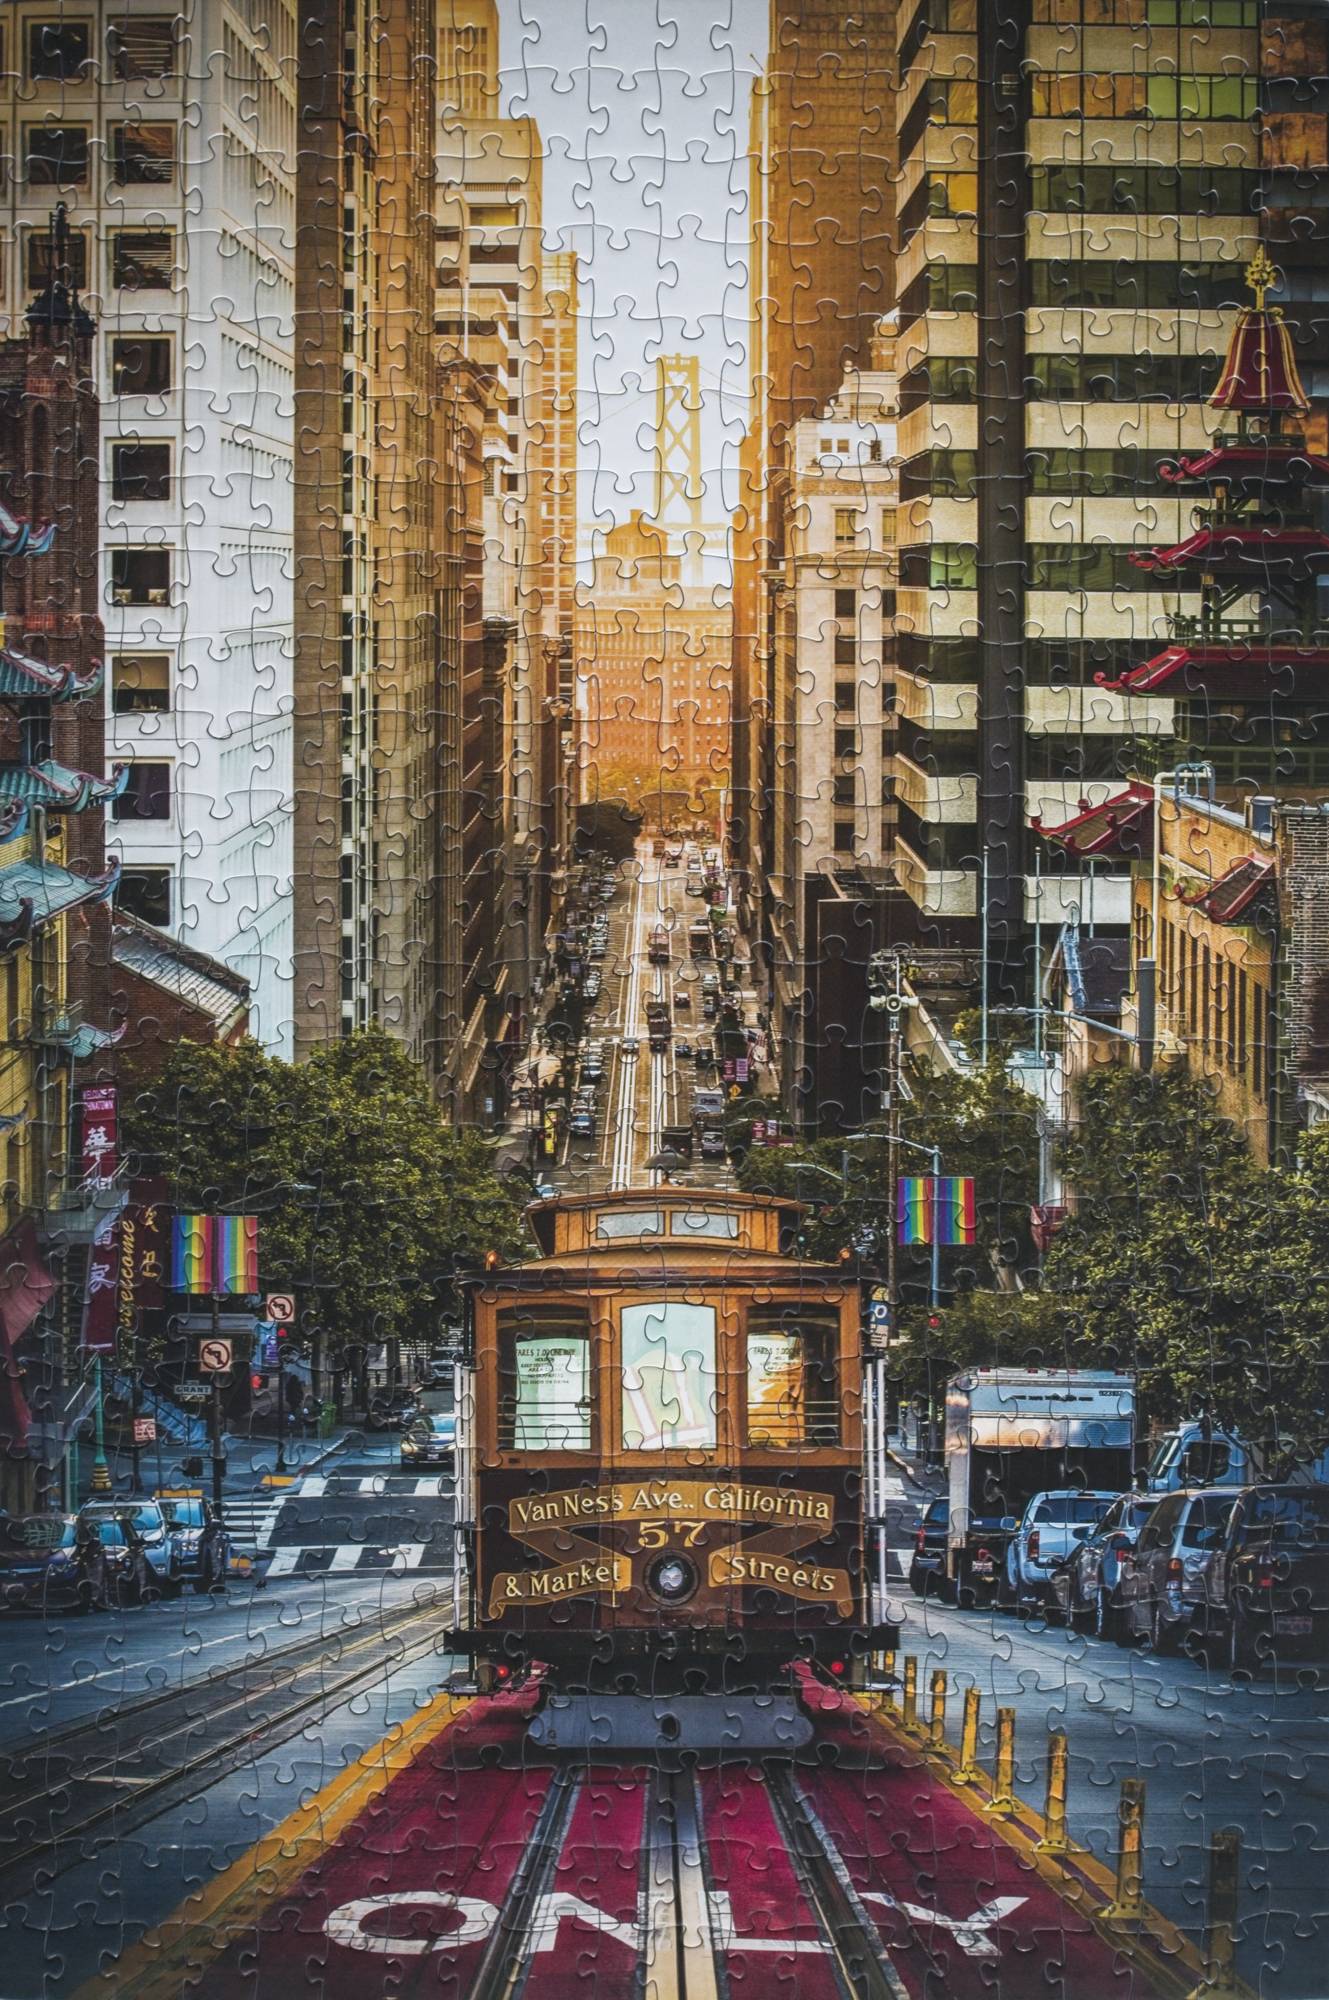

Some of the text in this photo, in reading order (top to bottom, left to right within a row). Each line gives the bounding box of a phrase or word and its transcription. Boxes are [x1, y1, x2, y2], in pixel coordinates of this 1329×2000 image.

[175, 1386, 210, 1394] GRANT
[516, 1501, 560, 1524] Van
[562, 1493, 625, 1517] Ness
[704, 1487, 830, 1520] California
[638, 1521, 707, 1548] 57
[505, 1556, 837, 1597] & Market Streets
